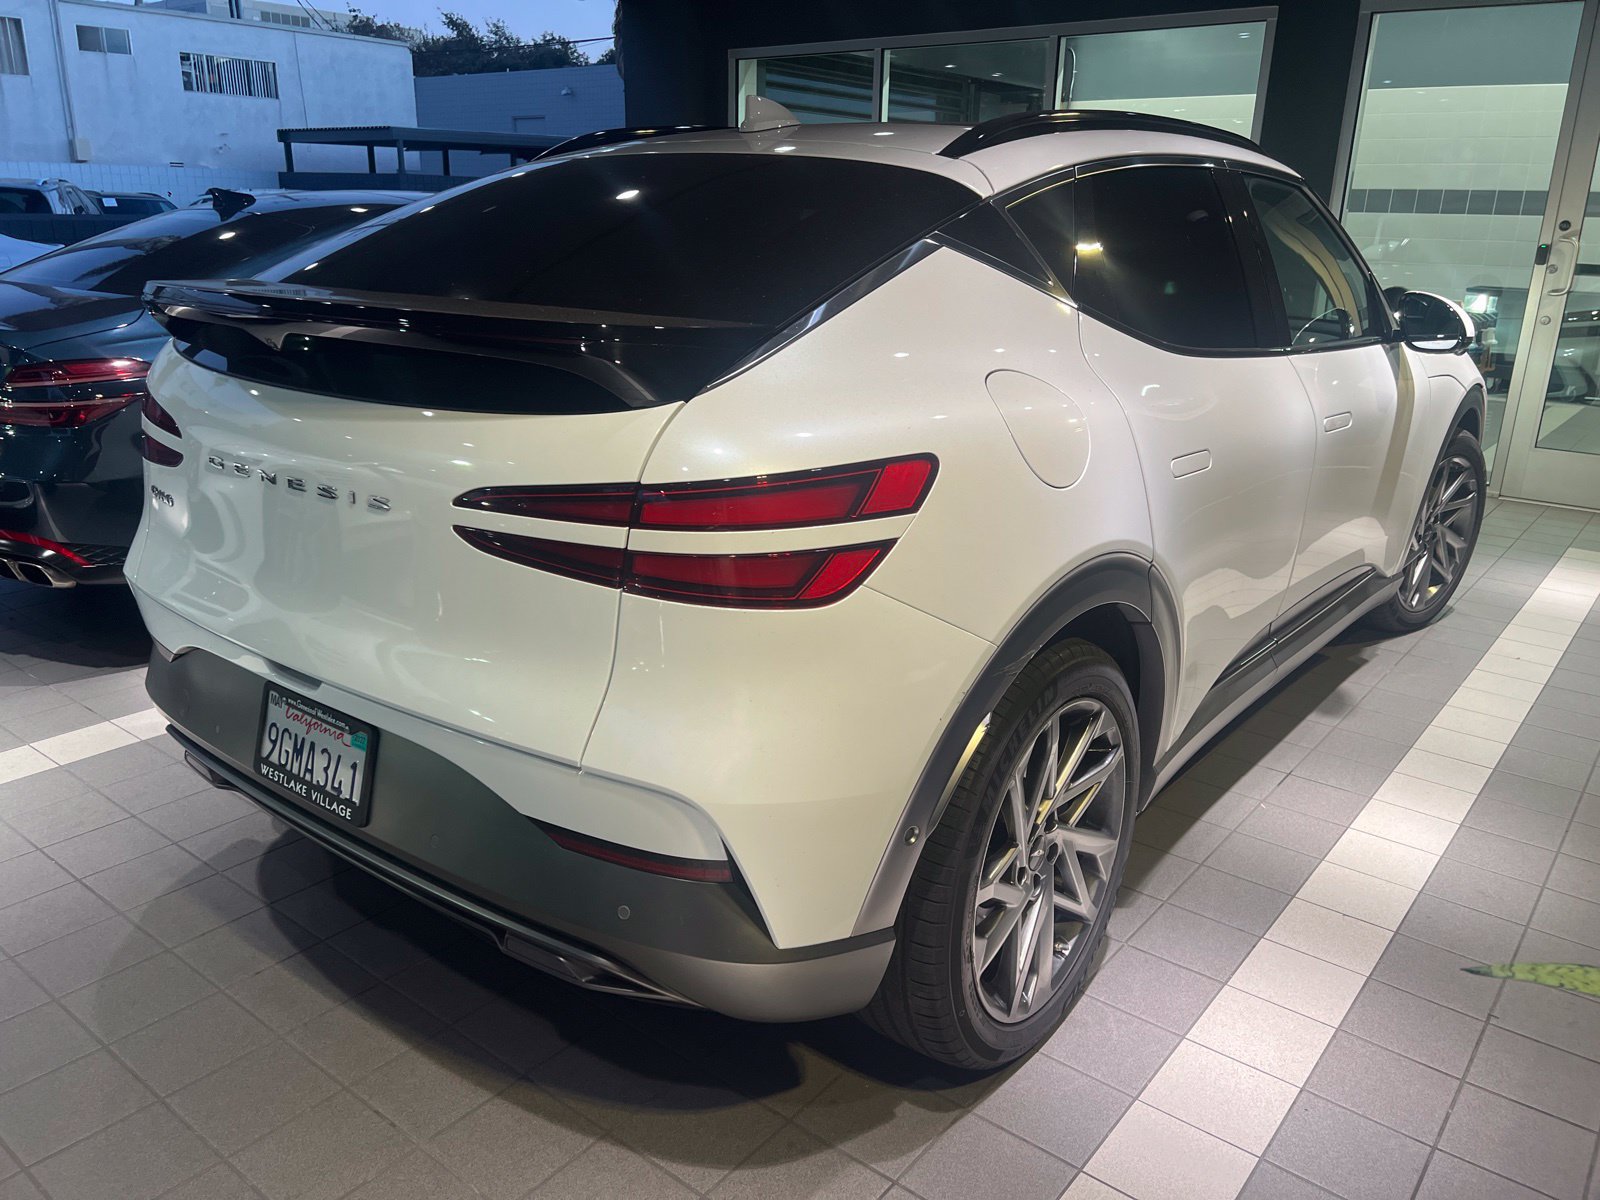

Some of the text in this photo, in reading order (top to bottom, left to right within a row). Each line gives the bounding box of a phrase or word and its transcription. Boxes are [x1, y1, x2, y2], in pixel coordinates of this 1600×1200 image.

[208, 455, 392, 512] GENESIS
[285, 706, 352, 747] California
[981, 682, 1058, 817] MICHELIN
[264, 722, 358, 802] 9GMA341
[260, 763, 352, 820] WESTLAKE VILLAGE
